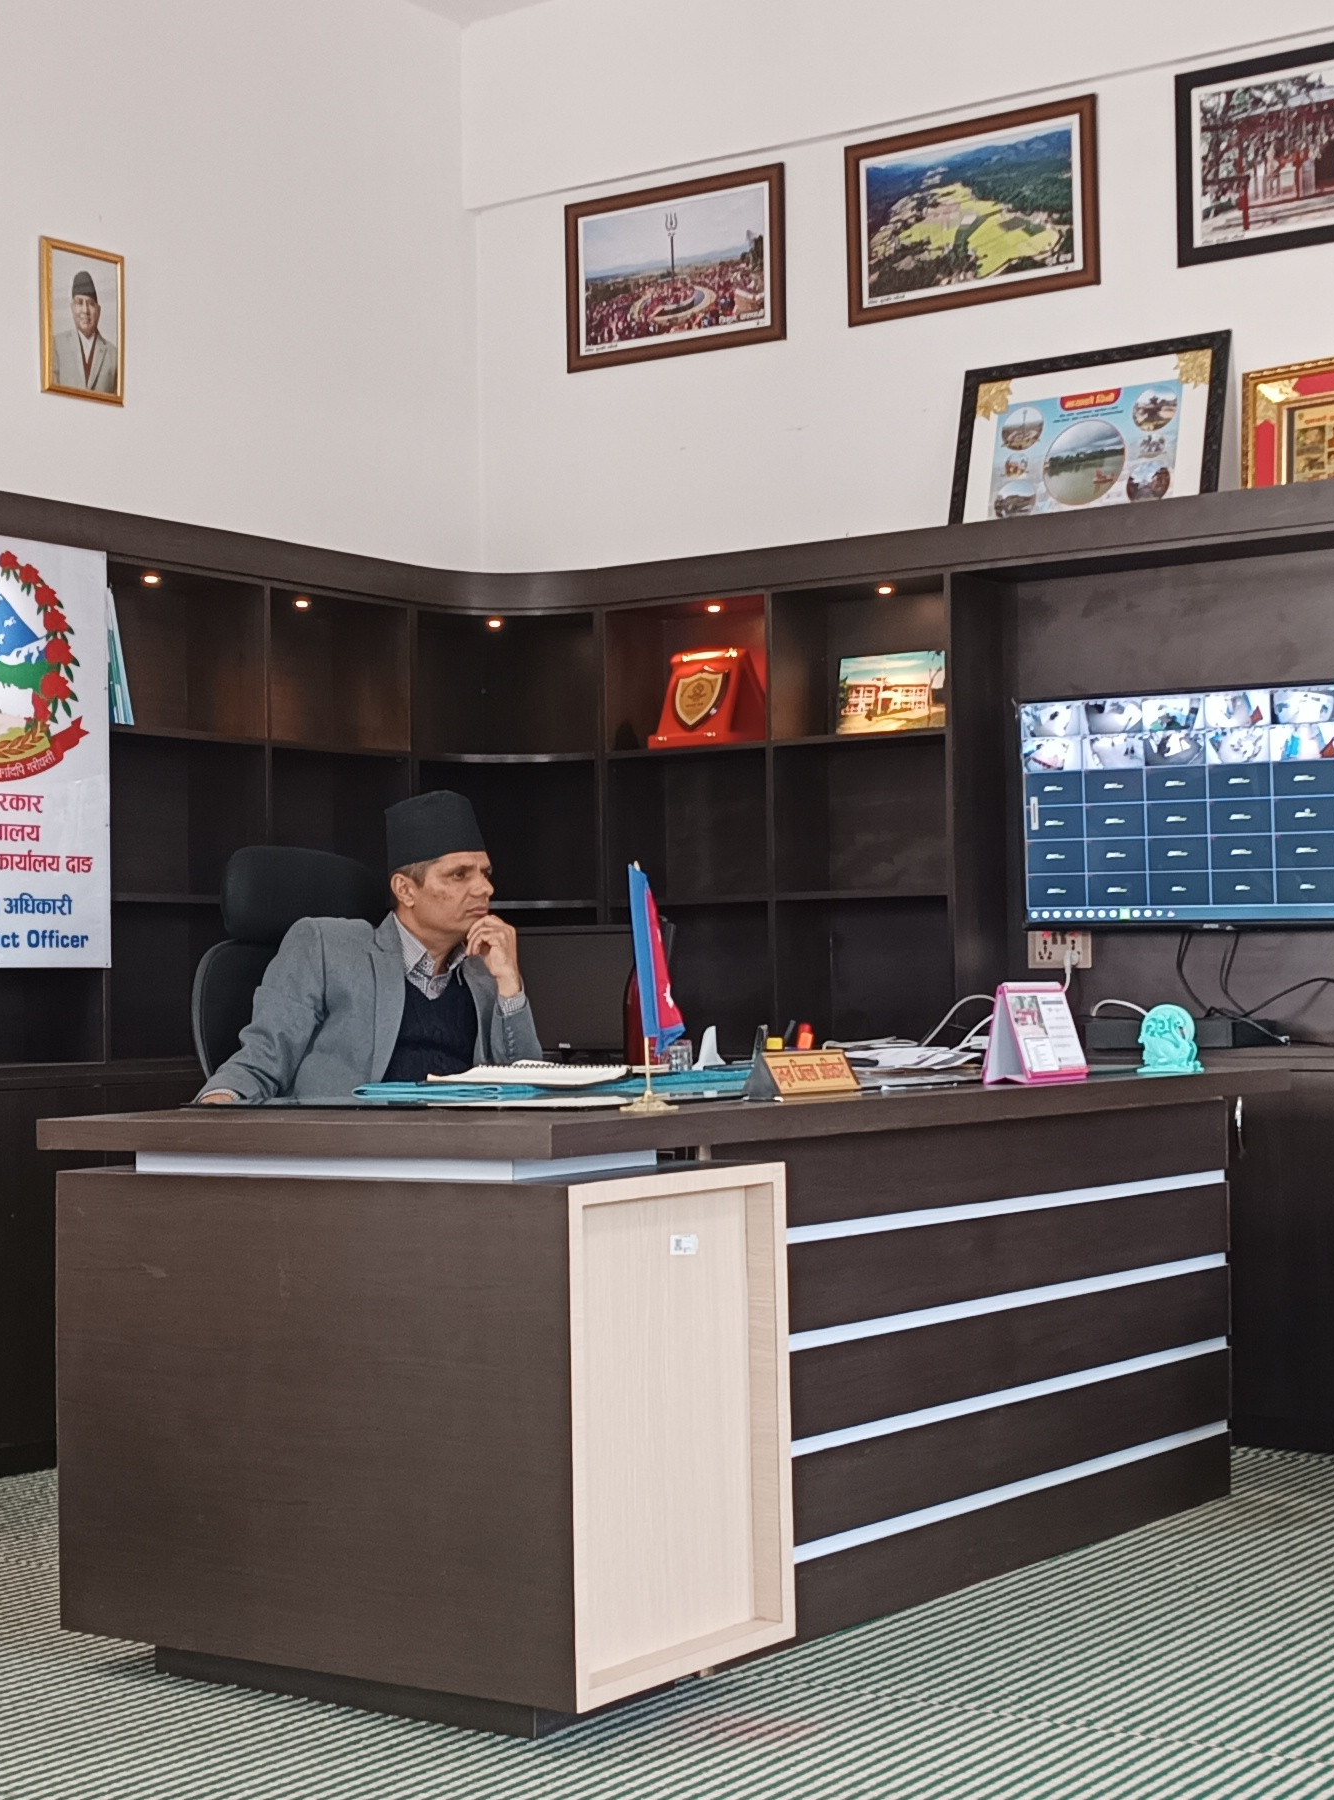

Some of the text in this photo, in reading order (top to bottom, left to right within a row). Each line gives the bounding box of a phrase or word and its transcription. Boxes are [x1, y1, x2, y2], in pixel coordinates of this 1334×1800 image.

[66, 855, 93, 873] दाङ
[4, 892, 72, 915] अधिकारी
[27, 930, 89, 949] Officer
